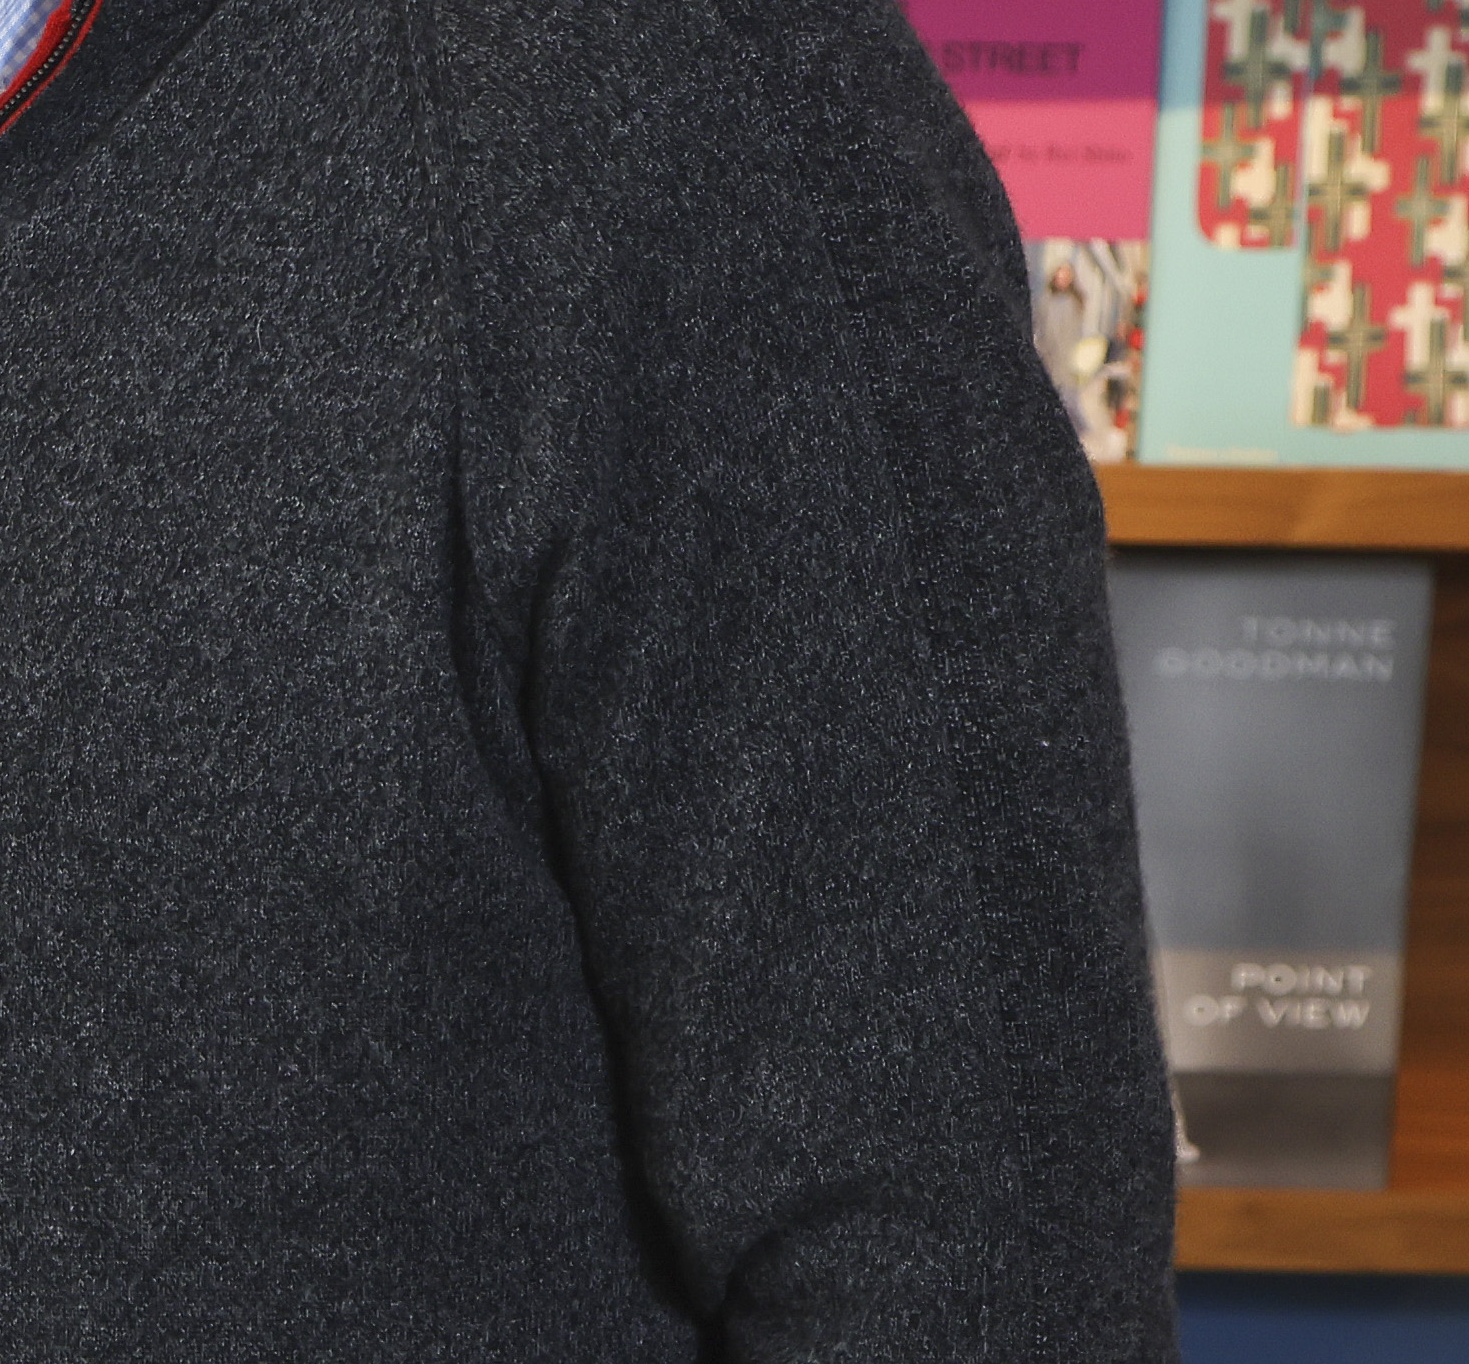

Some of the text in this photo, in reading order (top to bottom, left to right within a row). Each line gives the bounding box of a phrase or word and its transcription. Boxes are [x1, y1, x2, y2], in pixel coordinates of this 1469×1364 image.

[944, 40, 1085, 77] STREET
[1155, 646, 1393, 682] GOODMAN
[1231, 962, 1373, 996] POINT
[1184, 994, 1371, 1031] OF VIEW
